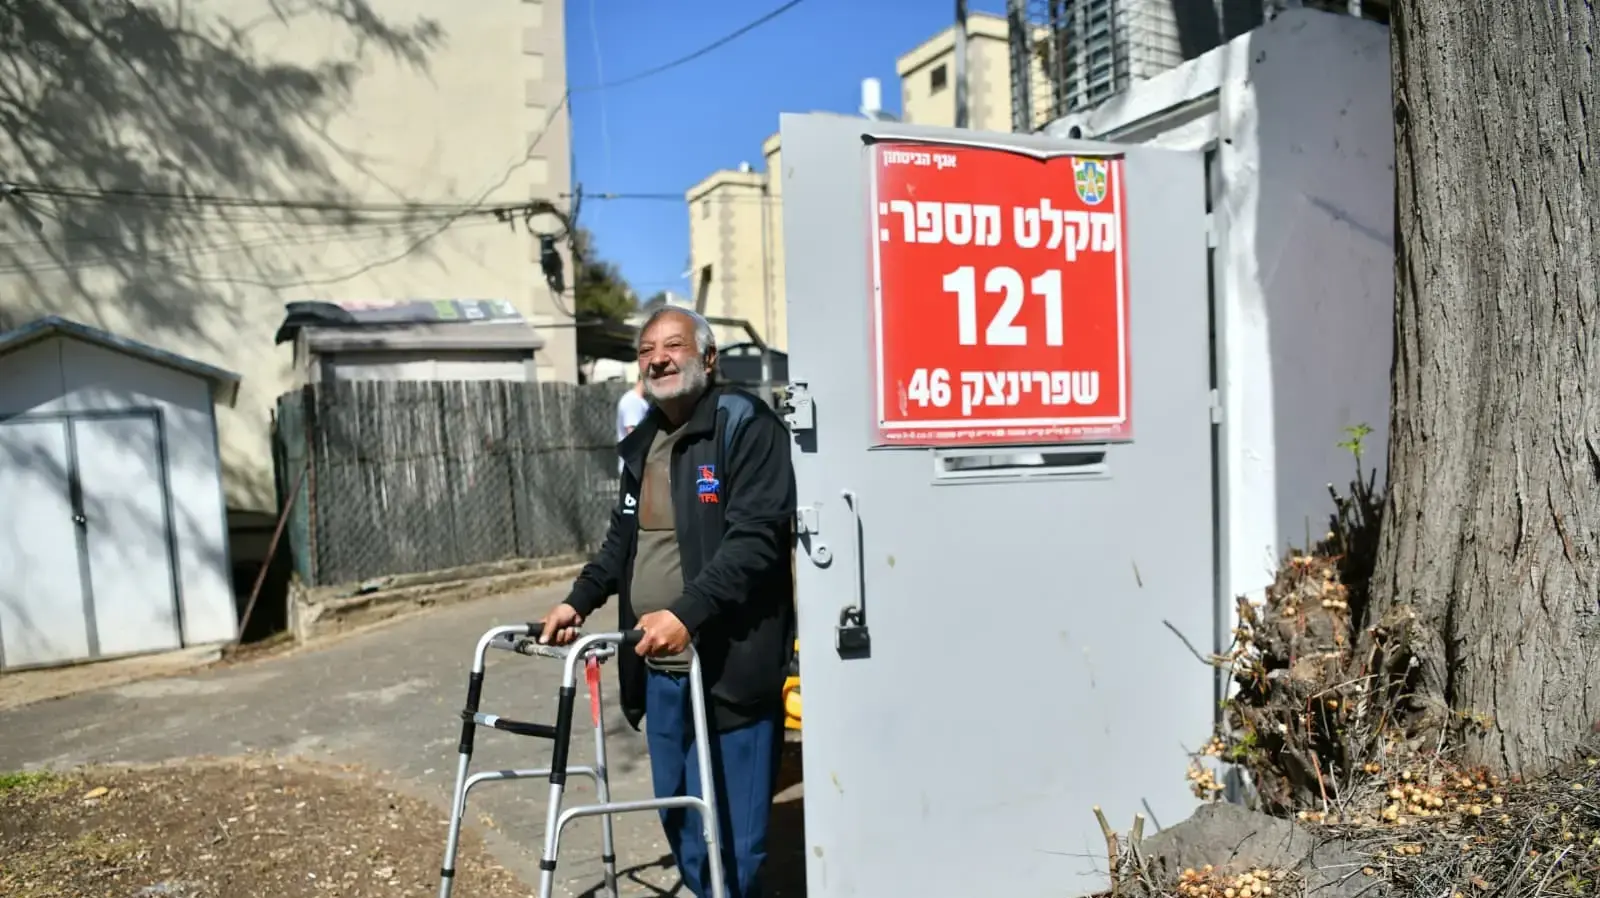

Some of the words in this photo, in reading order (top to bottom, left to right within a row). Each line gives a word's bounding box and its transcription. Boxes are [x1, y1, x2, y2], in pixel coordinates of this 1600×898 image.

[932, 153, 957, 170] אגף
[879, 199, 1001, 246] מספר:
[1013, 198, 1116, 262] מקלט
[942, 265, 1064, 347] 121
[908, 368, 951, 407] 46
[960, 370, 1099, 416] שפרינצק
